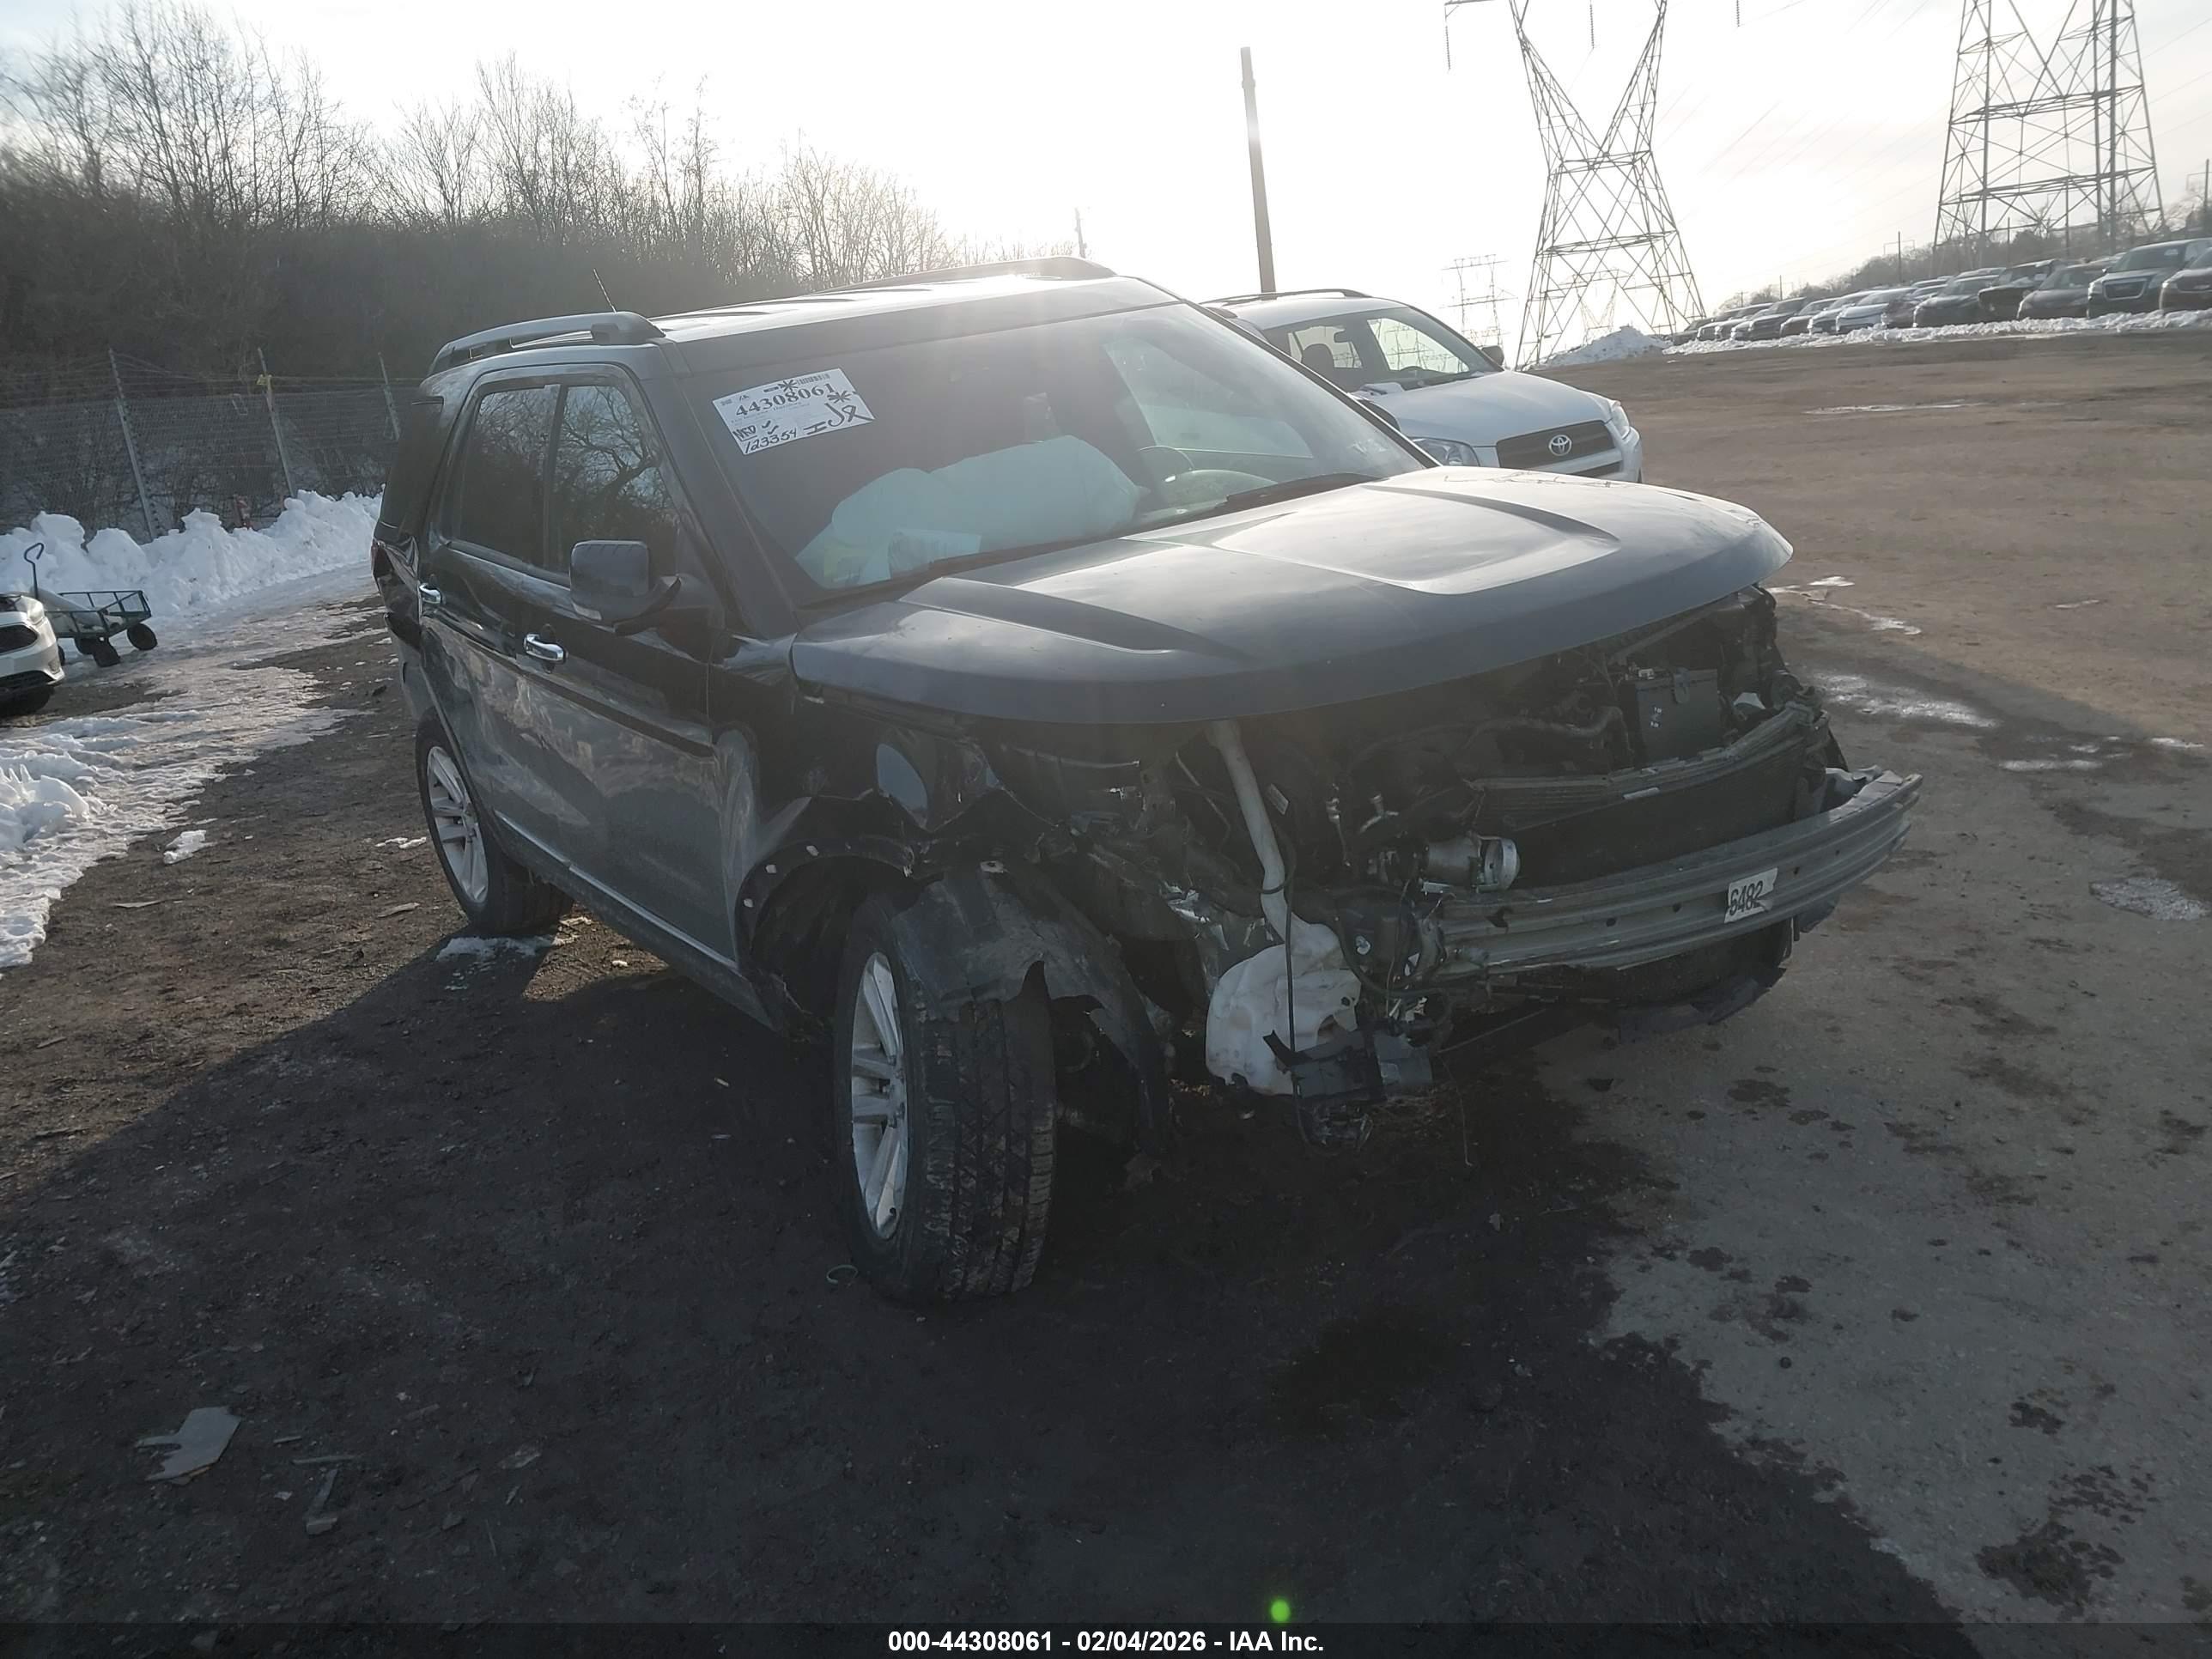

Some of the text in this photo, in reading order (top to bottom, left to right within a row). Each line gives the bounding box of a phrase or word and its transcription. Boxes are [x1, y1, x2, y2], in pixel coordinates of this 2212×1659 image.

[736, 383, 835, 417] 44308061
[745, 428, 797, 454] 123354
[1729, 880, 1764, 916] 6482
